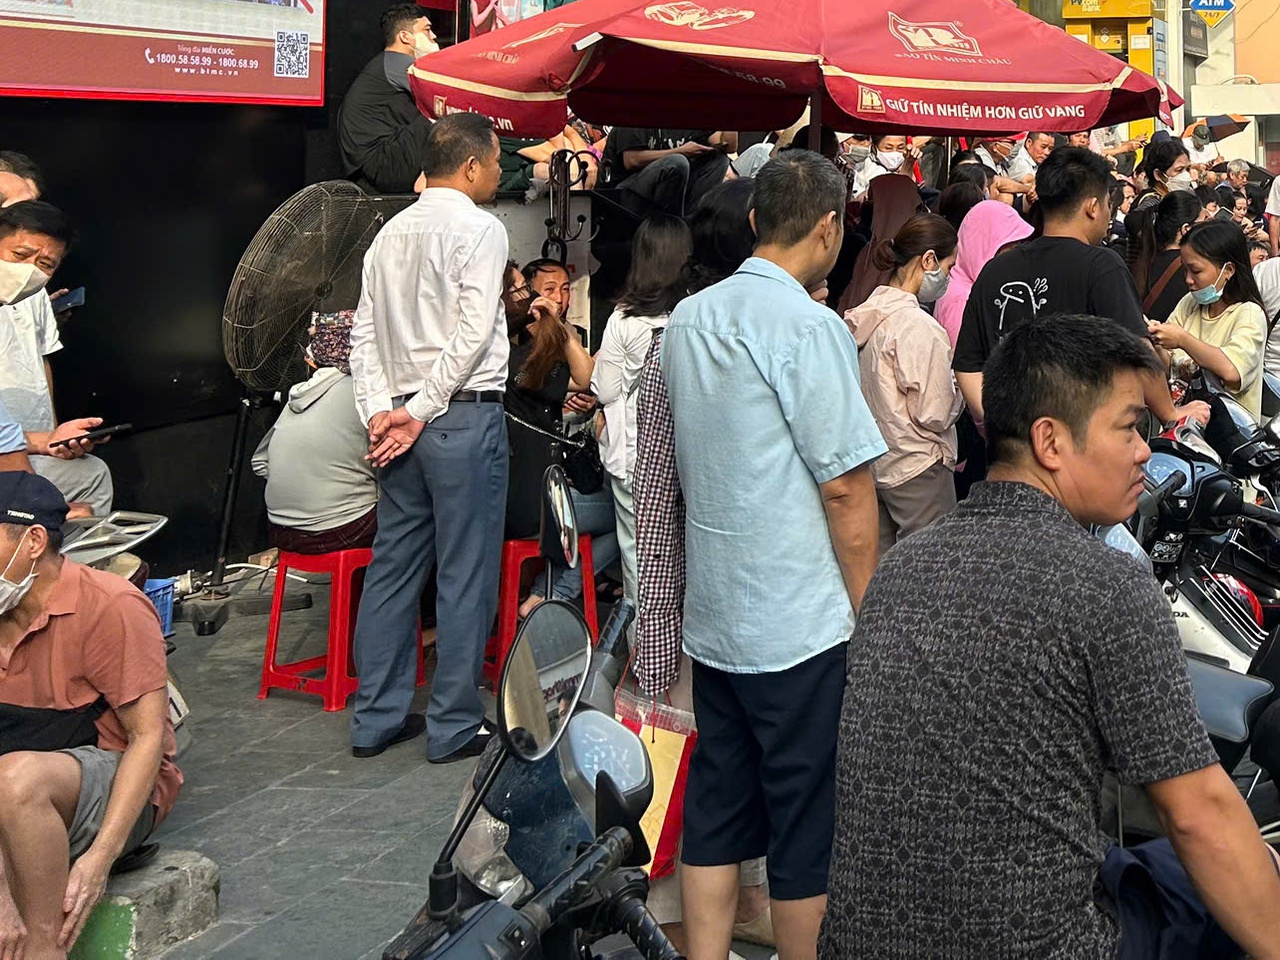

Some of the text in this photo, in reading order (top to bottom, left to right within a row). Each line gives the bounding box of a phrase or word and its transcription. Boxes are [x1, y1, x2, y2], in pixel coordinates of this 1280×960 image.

[1204, 11, 1220, 19] 24/7
[156, 53, 211, 66] 1800.58.58.99
[219, 58, 259, 69] 1800.68.99
[886, 98, 1085, 120] GIỮ TÍN NHIỆM HƠN GIỮ VÀNG
